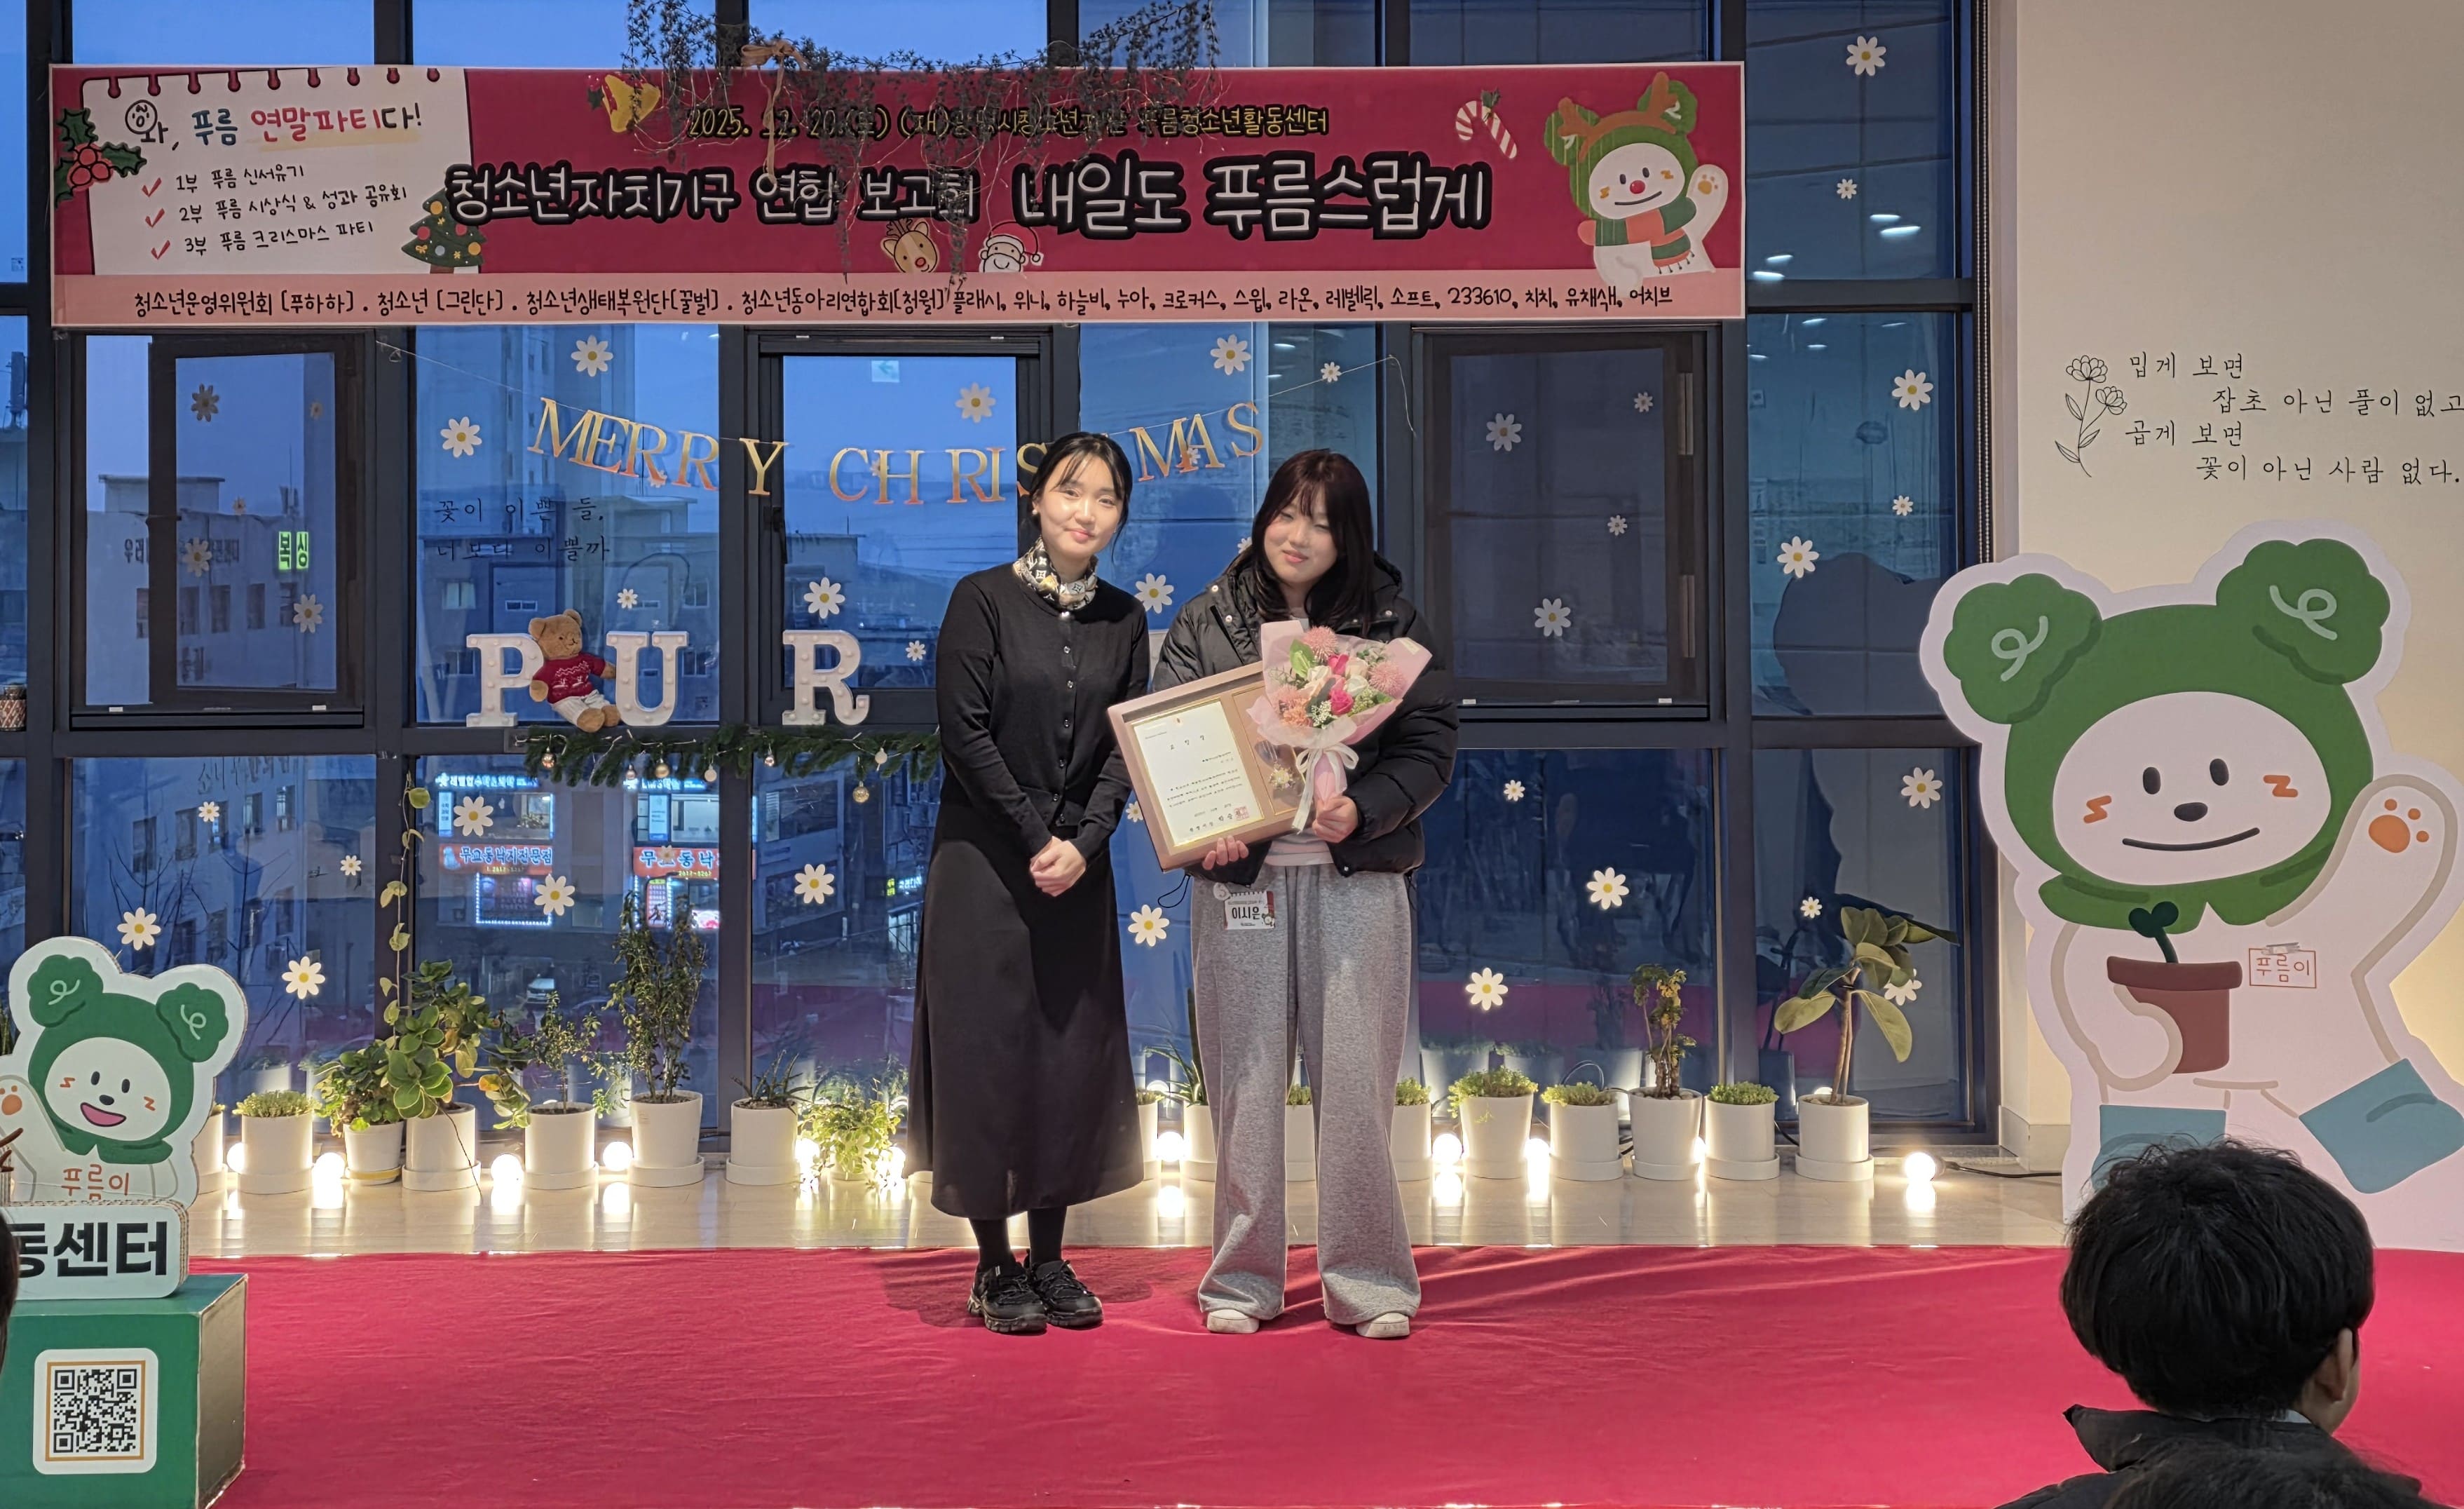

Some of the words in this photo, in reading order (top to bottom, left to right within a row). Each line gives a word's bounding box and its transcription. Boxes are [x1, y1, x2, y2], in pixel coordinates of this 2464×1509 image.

[192, 108, 238, 146] 푸름
[251, 102, 421, 142] 연말파티다!
[689, 107, 750, 135] 2025.
[176, 174, 198, 193] 1부
[211, 168, 237, 189] 푸름
[244, 163, 305, 185] 신서유기
[179, 203, 203, 223] 2부
[217, 198, 241, 219] 푸름
[248, 193, 297, 214] 시상식
[304, 196, 316, 210] &
[322, 189, 358, 210] 성과
[365, 182, 408, 203] 공유회
[449, 165, 736, 221] 청소년자치기구
[756, 164, 837, 219] 연합
[1020, 157, 1183, 230] 내일도
[1211, 157, 1485, 233] 푸름스럽게
[184, 235, 207, 255] 3부
[220, 230, 246, 252] 푸름
[252, 224, 330, 248] 크리스마스
[336, 219, 374, 237] 파티
[135, 288, 273, 318] 청소년운영위원회
[378, 288, 428, 316] 청소년
[1629, 285, 1673, 307] 어치브
[2130, 351, 2176, 379] 밉게
[2192, 353, 2243, 379] 보면
[2212, 386, 2267, 414] 잡초
[2283, 387, 2333, 415] 아닌
[2348, 388, 2400, 417] 풀이
[527, 396, 790, 496] MERRY
[2125, 419, 2175, 447] 곱게
[2191, 421, 2243, 447] 보면
[2196, 454, 2247, 481] 꽃이
[2262, 455, 2313, 482] 아닌
[2328, 455, 2385, 482] 사람
[2401, 456, 2461, 485] 없다.
[434, 497, 482, 523] 꽃이
[2256, 953, 2310, 983] 푸름이
[60, 1163, 130, 1200] 푸름이
